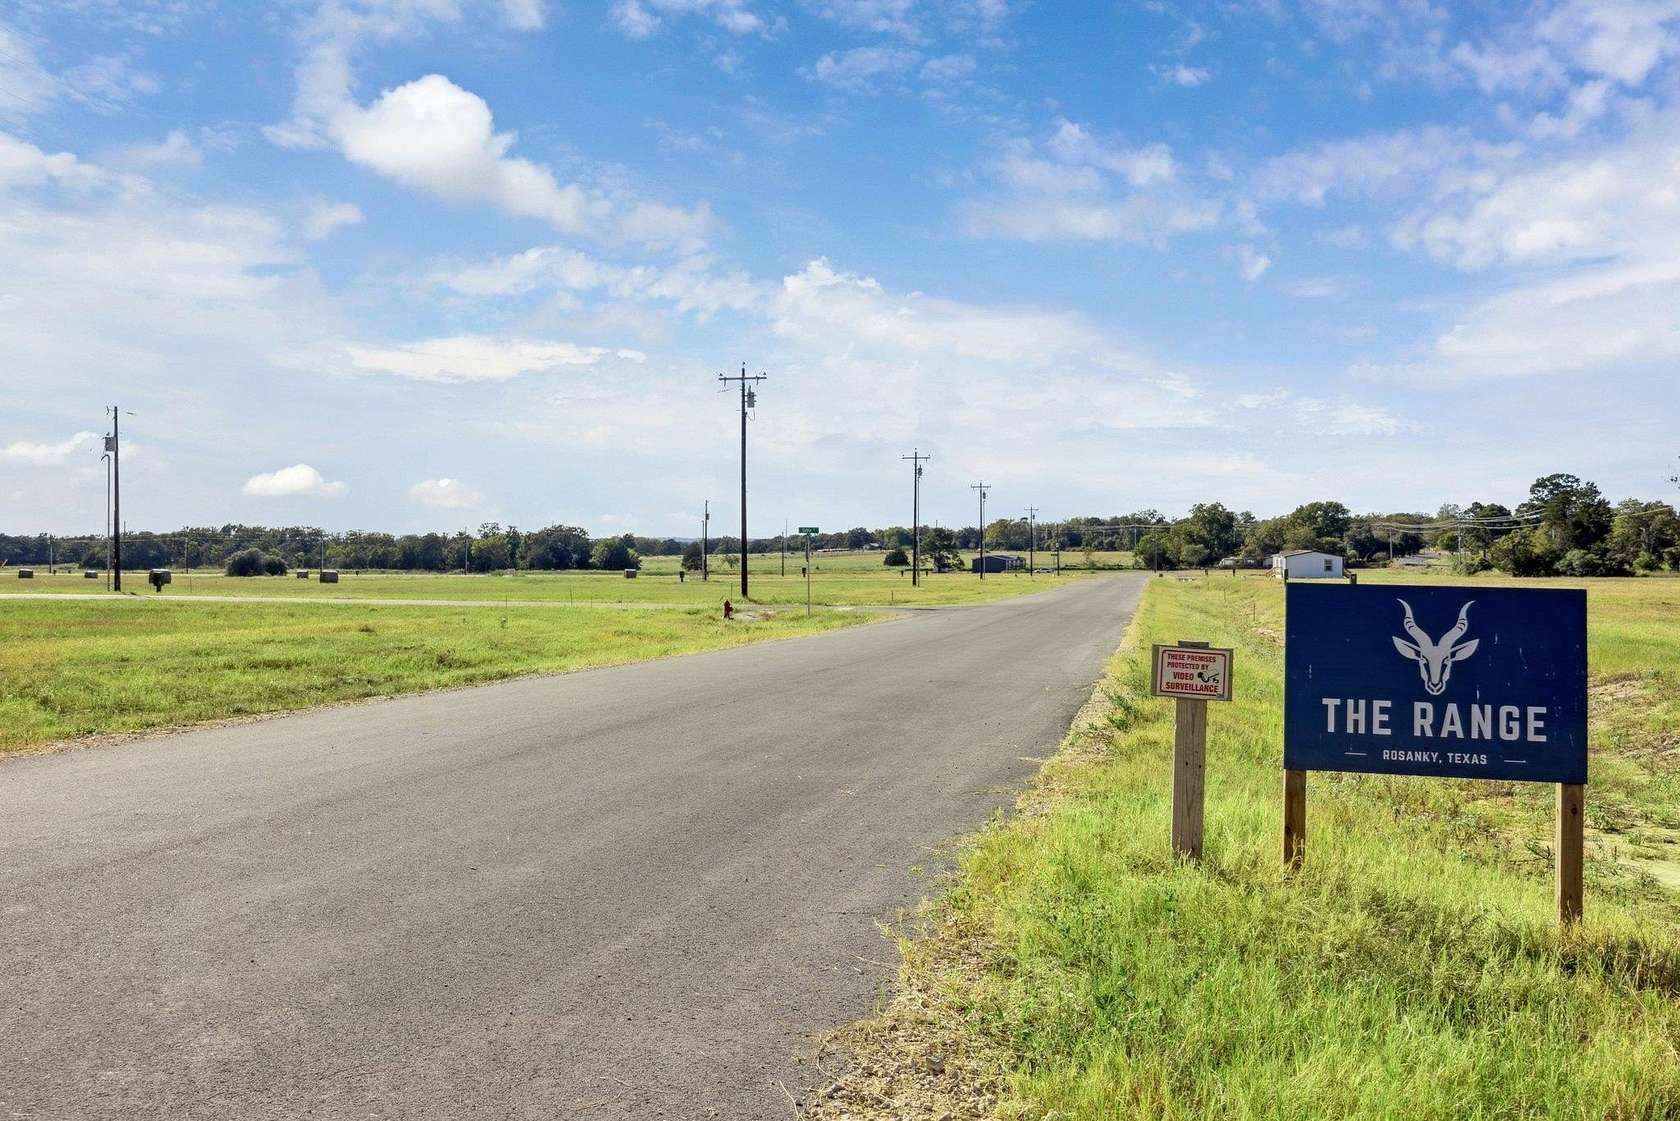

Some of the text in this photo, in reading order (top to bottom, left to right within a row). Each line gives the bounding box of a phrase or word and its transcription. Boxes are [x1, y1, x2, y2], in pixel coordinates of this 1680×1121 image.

[1167, 653, 1217, 663] THESE PREMISES
[1167, 662, 1200, 670] PROTECTED
[1173, 671, 1194, 681] VIDEO
[1165, 681, 1218, 693] SURVEILLANCE
[1322, 698, 1548, 742] THE RANGE
[1383, 750, 1487, 765] ROSANKY, TEXAS
